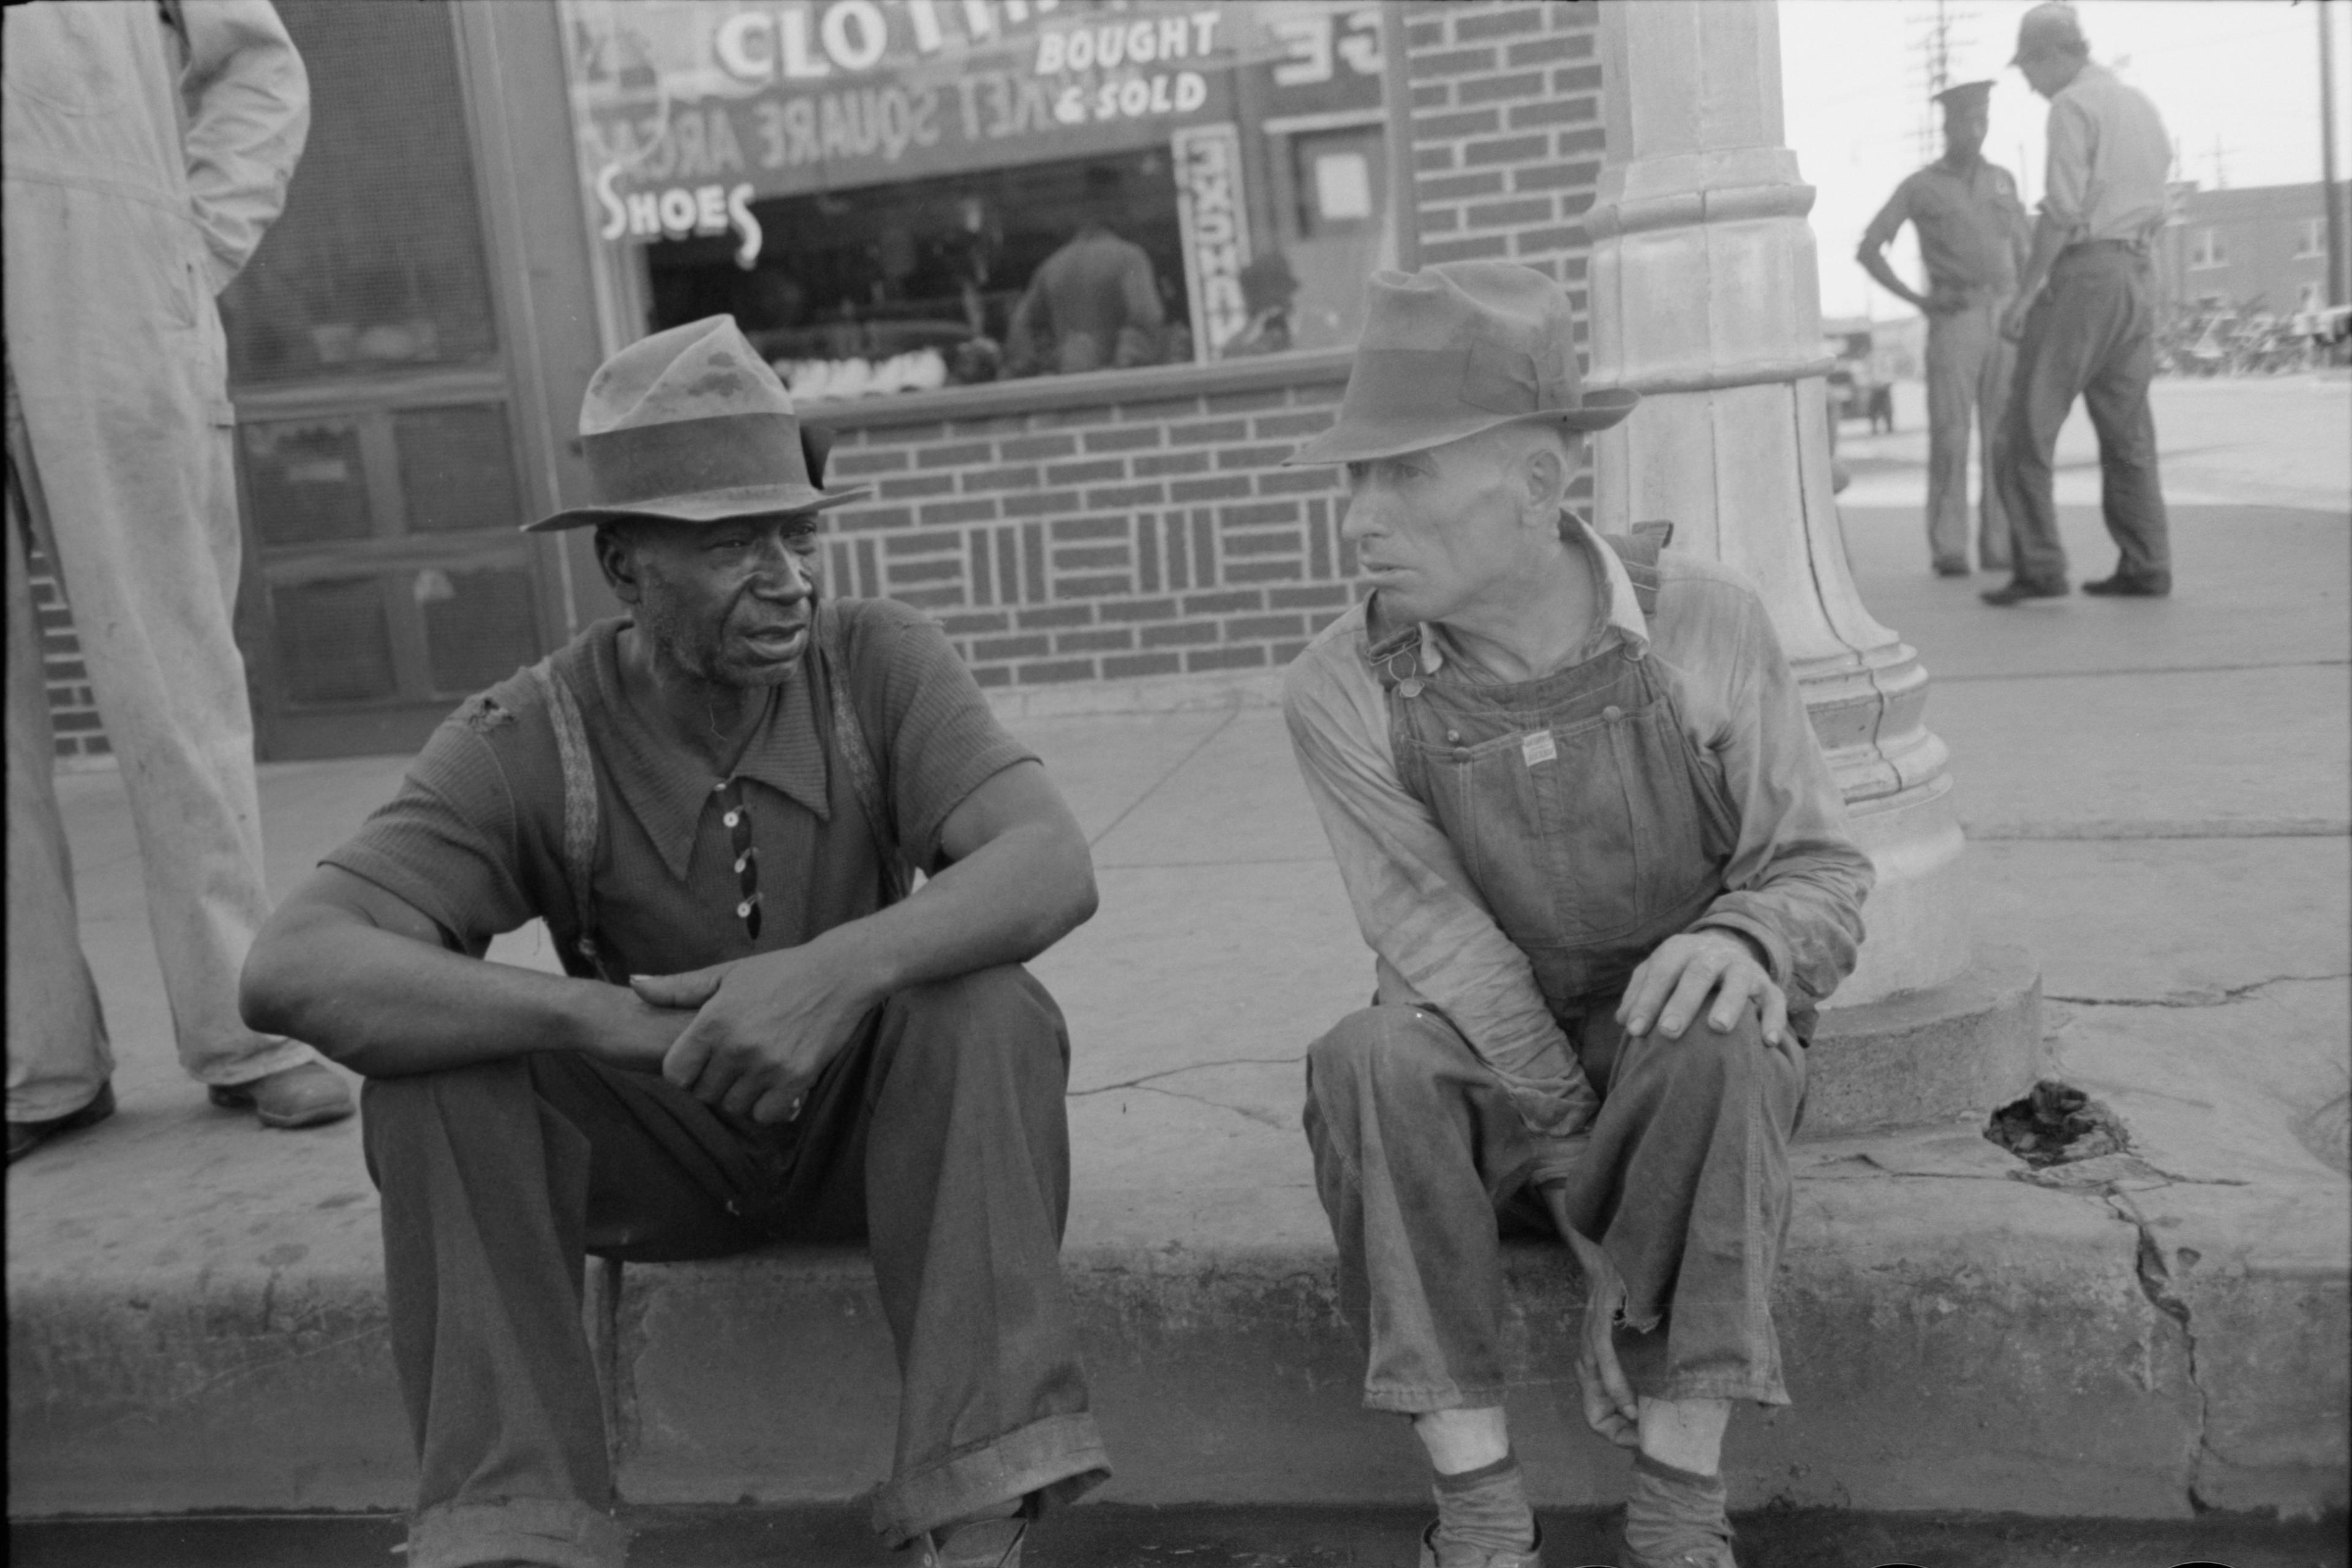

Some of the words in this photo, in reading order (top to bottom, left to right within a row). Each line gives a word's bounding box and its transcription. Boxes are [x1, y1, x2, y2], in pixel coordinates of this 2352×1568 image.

[1035, 10, 1222, 75] BOUGHT
[1054, 85, 1087, 124] &
[1094, 71, 1207, 119] SOLD
[595, 162, 763, 267] SHOES
